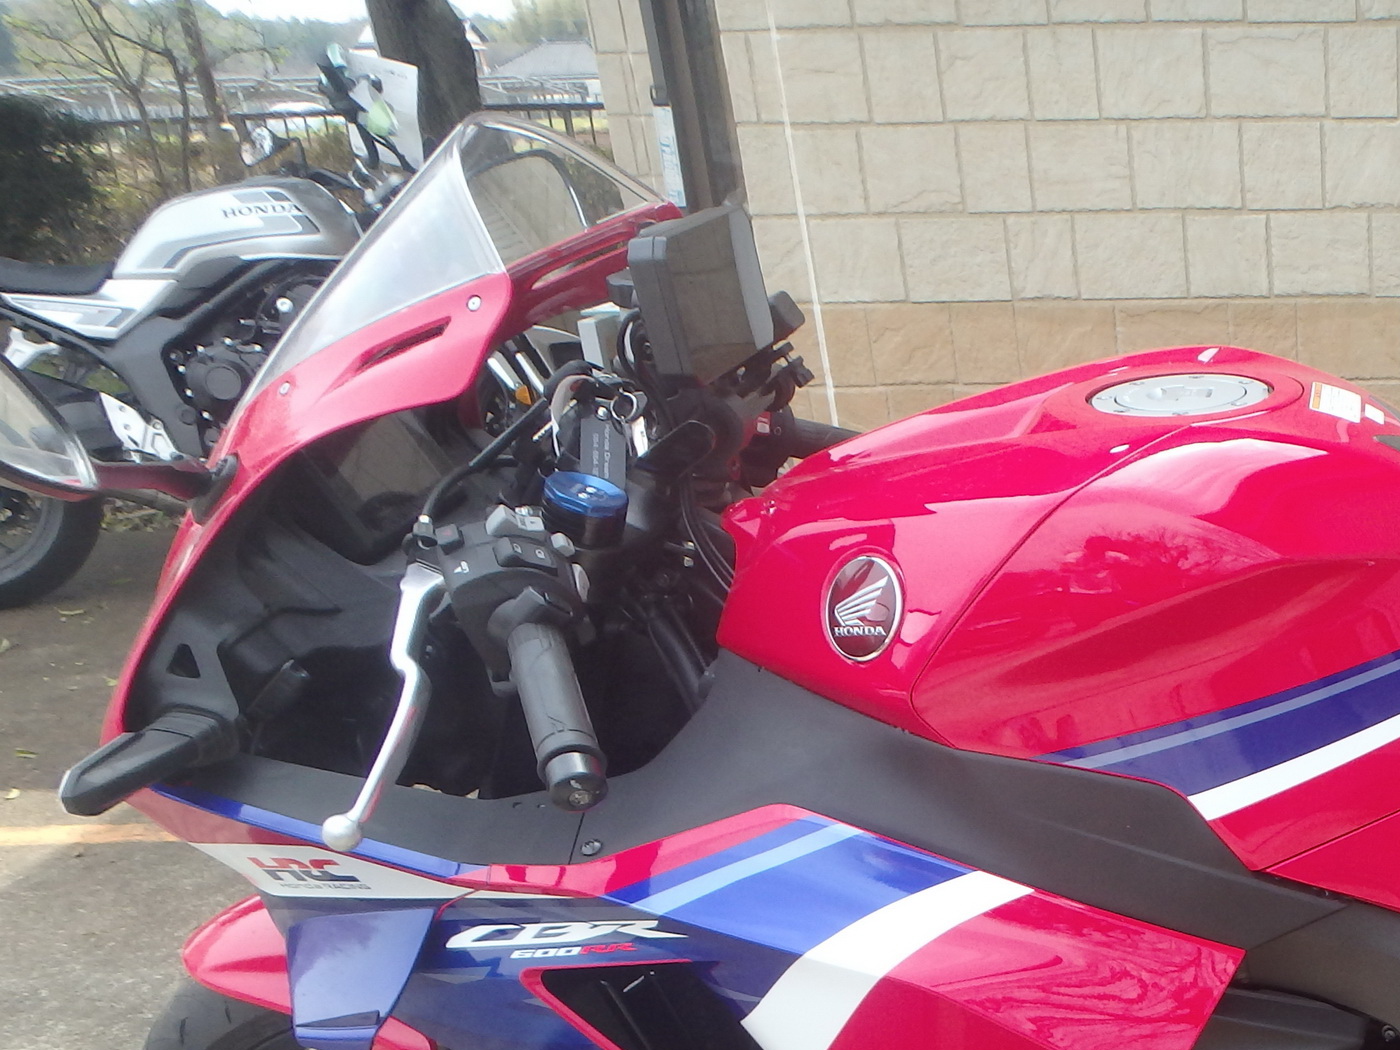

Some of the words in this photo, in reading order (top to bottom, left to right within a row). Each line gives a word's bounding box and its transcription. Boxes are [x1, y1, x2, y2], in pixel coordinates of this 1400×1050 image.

[221, 203, 299, 218] HONDA
[834, 625, 886, 637] HONDA
[246, 856, 361, 882] HRC
[445, 920, 690, 948] CBR
